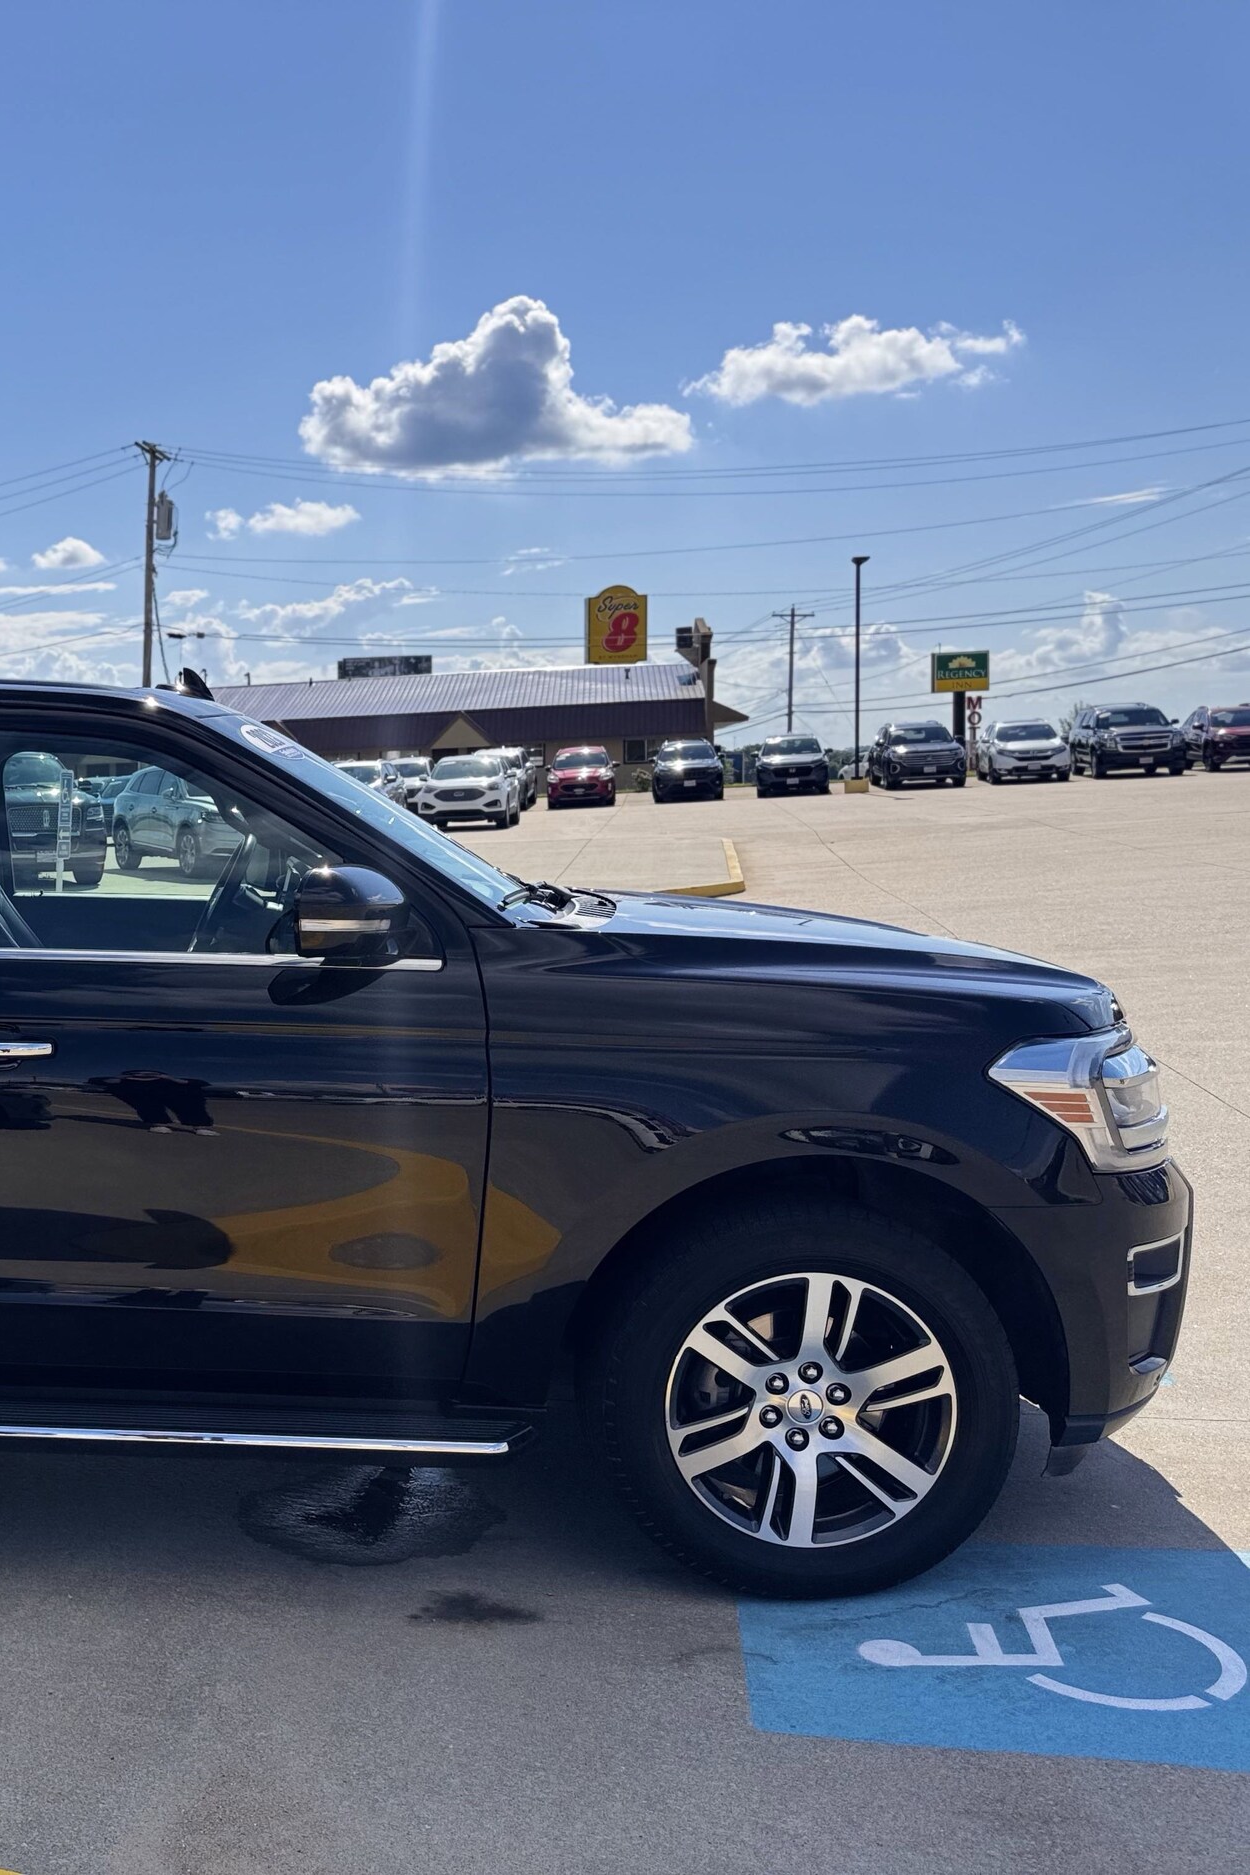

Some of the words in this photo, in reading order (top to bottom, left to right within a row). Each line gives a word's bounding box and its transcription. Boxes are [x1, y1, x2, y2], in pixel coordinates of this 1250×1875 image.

[597, 596, 638, 620] Super
[601, 611, 639, 653] 8
[937, 669, 986, 679] REGENCY
[952, 681, 972, 689] INN
